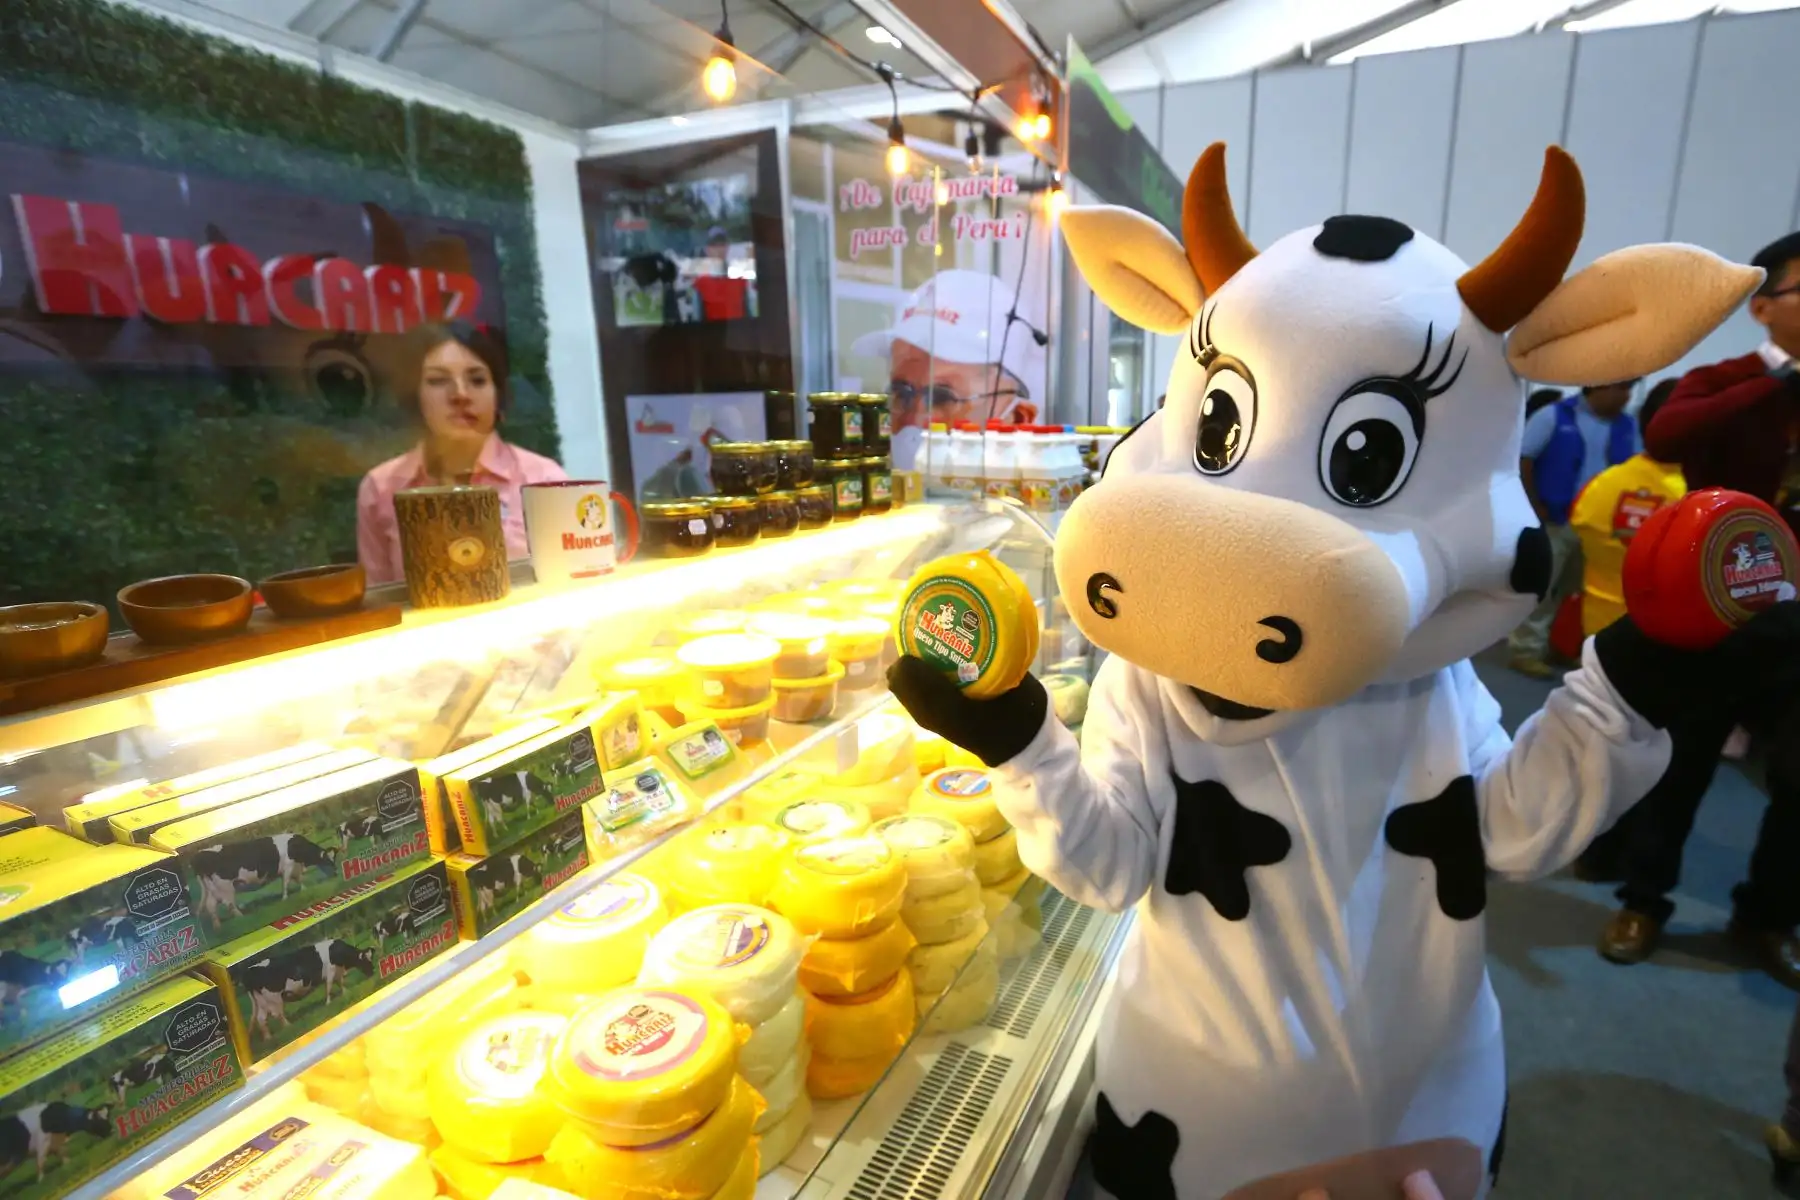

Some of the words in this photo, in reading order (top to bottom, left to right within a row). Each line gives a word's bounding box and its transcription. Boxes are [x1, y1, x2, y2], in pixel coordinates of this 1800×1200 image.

[895, 174, 1014, 211] Cajmarca
[850, 228, 905, 256] para
[913, 627, 934, 647] Queso
[933, 639, 950, 657] Tipo
[919, 610, 975, 659] HUACARIZ
[342, 830, 428, 881] HUACARIZ
[132, 886, 178, 910] SATURADAS
[135, 882, 155, 895] ALTO
[156, 876, 168, 886] EN
[137, 883, 170, 900] GRASAS
[379, 918, 455, 978] HUACARIZ
[172, 1018, 217, 1046] SATURADAS
[176, 1016, 195, 1030] ALTO
[196, 1009, 207, 1019] EN
[177, 1016, 209, 1036] GRASAS
[604, 1012, 676, 1056] HUACARIZ
[115, 1053, 234, 1139] HUACARIZ
